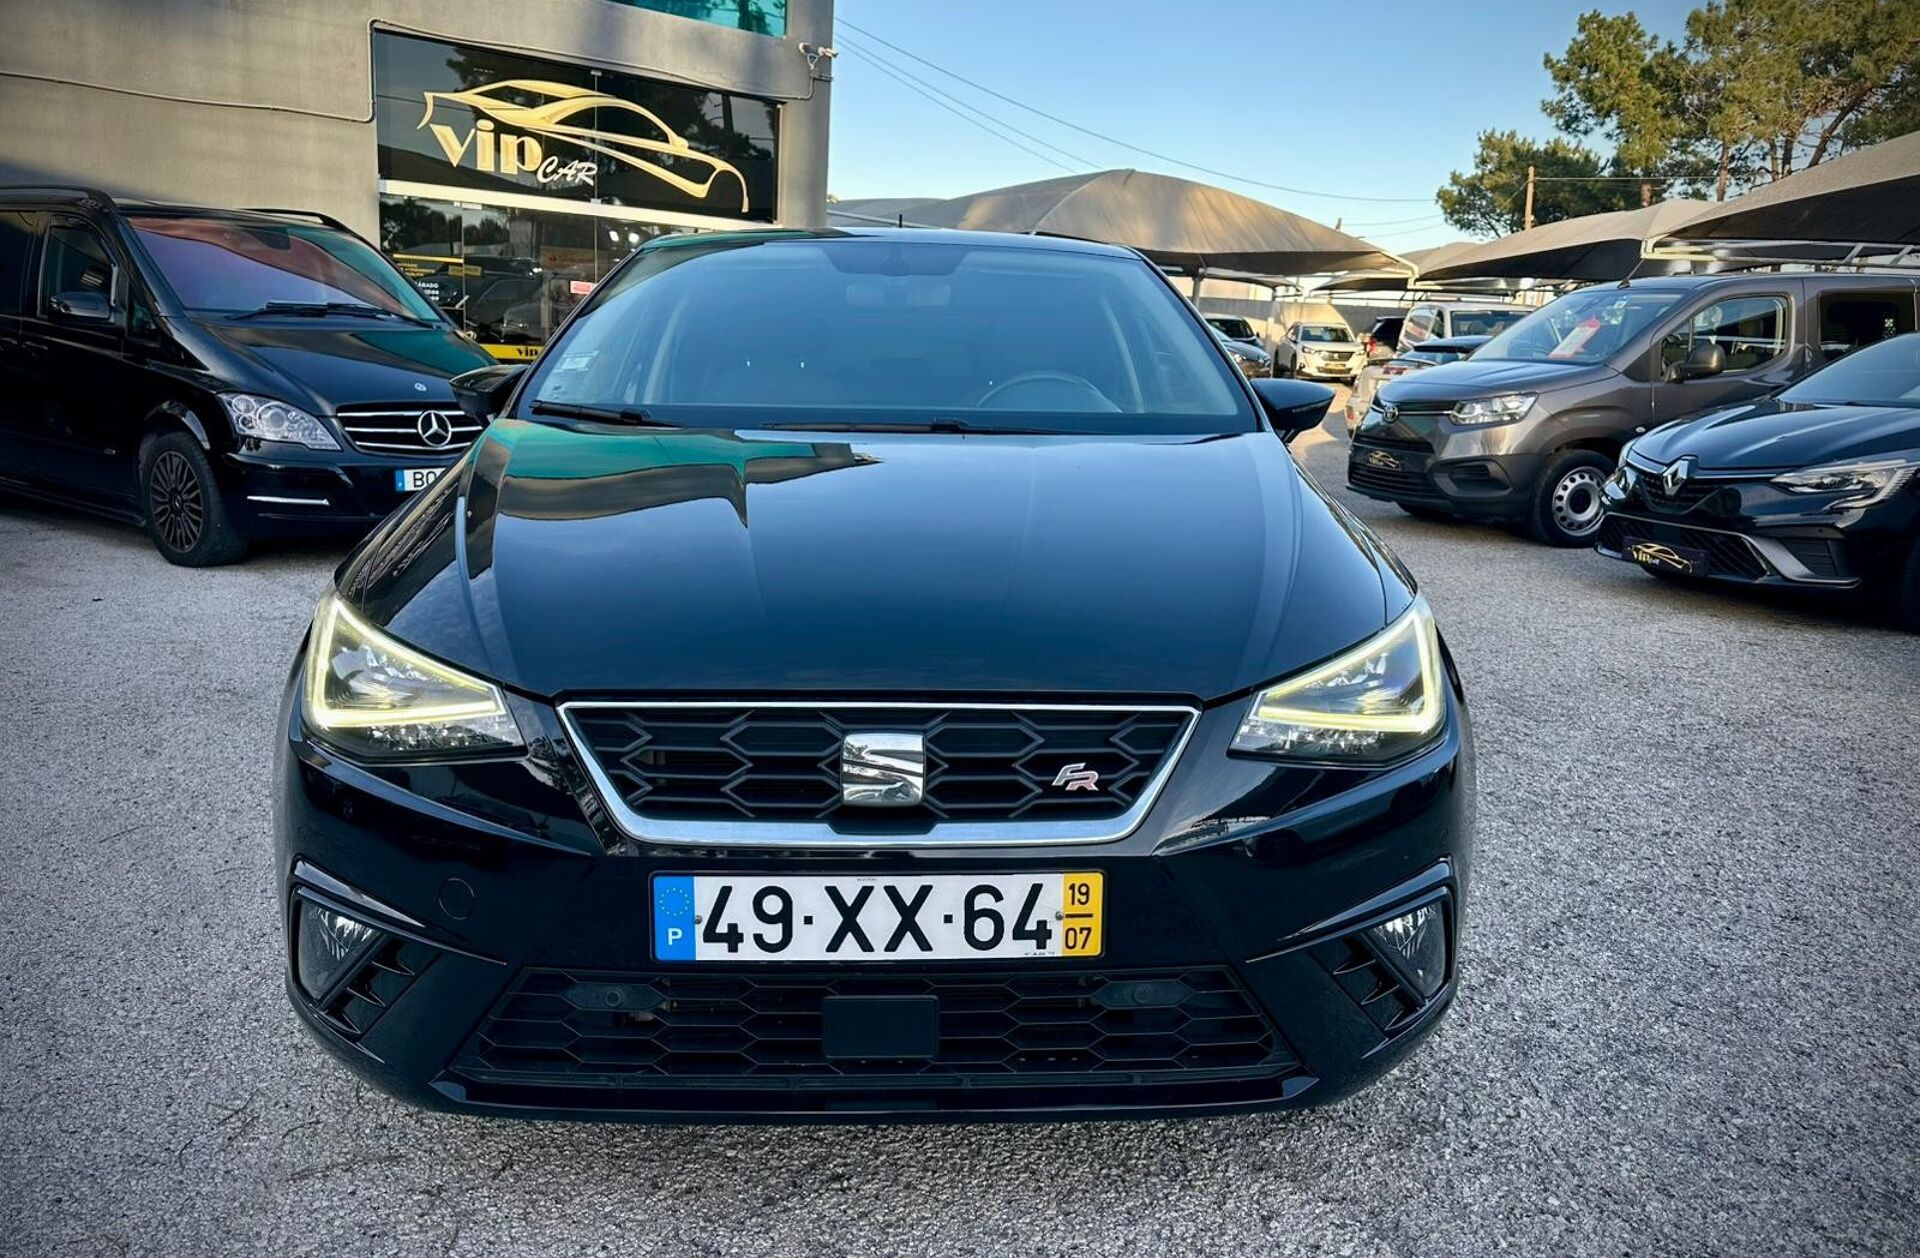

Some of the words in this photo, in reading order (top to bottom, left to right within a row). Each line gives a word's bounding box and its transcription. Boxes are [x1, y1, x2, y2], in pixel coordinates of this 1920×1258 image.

[536, 156, 598, 186] CAR
[1051, 762, 1099, 791] FR
[1068, 882, 1090, 906] 19
[667, 927, 683, 946] P
[1064, 927, 1092, 950] 07
